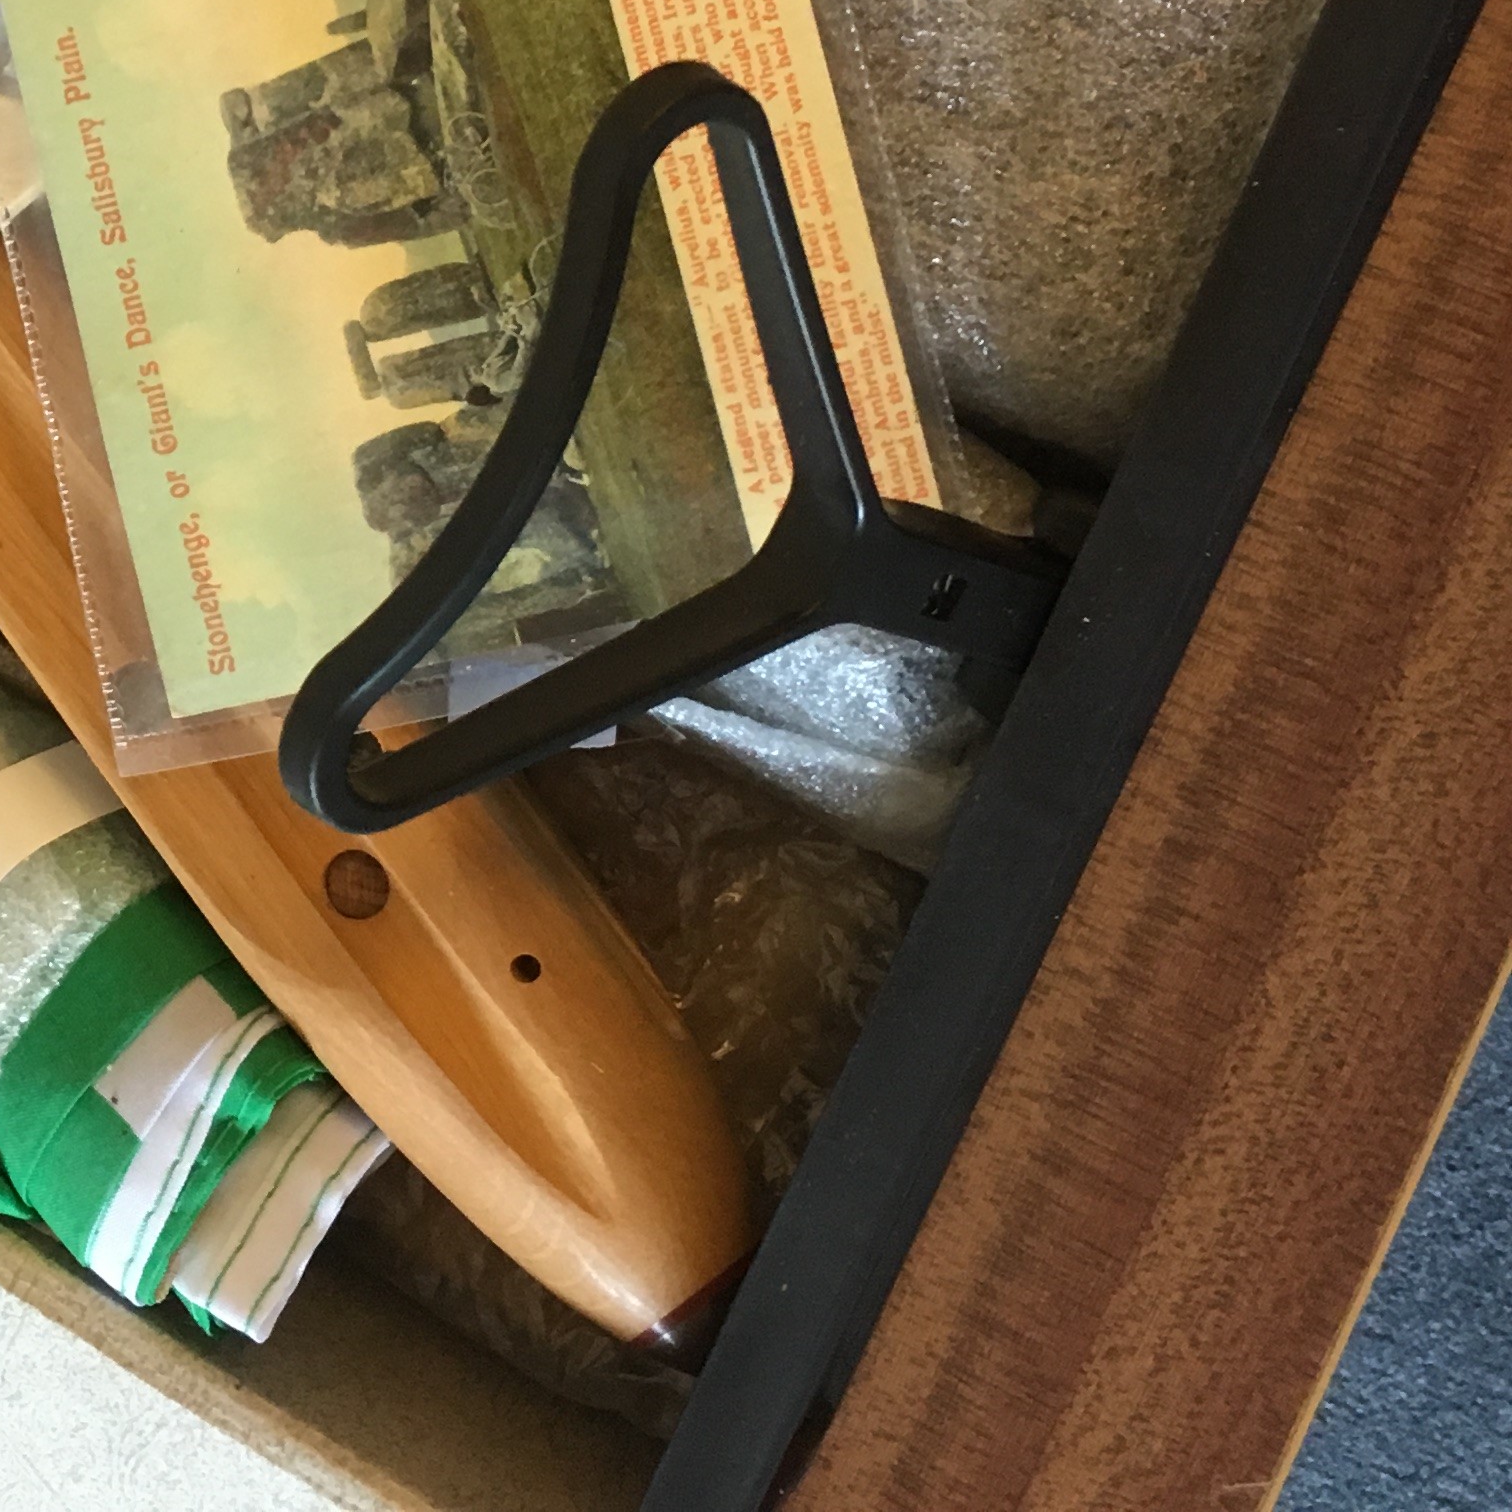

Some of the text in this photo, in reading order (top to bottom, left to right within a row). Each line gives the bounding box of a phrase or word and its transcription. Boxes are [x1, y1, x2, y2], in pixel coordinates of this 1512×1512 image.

[700, 0, 725, 45] who
[765, 25, 792, 70] held
[750, 41, 780, 101] When
[782, 71, 804, 114] was
[678, 152, 712, 227] erected
[772, 121, 810, 211] removal.
[790, 118, 834, 218] solemnity
[700, 235, 721, 261] be
[797, 218, 826, 269] their
[821, 220, 850, 275] great
[711, 270, 731, 292] to
[838, 279, 854, 293] a
[839, 297, 865, 337] and
[55, 26, 236, 677] Stonehenge, or Giant's Dance, Salisbury Plain.
[721, 302, 762, 410] monument
[852, 341, 892, 434] Ambrius,
[880, 370, 904, 405] the
[725, 401, 760, 475] Legend
[891, 409, 911, 431] in
[752, 417, 784, 485] proper
[897, 434, 930, 500] buried
[746, 477, 766, 496] A
